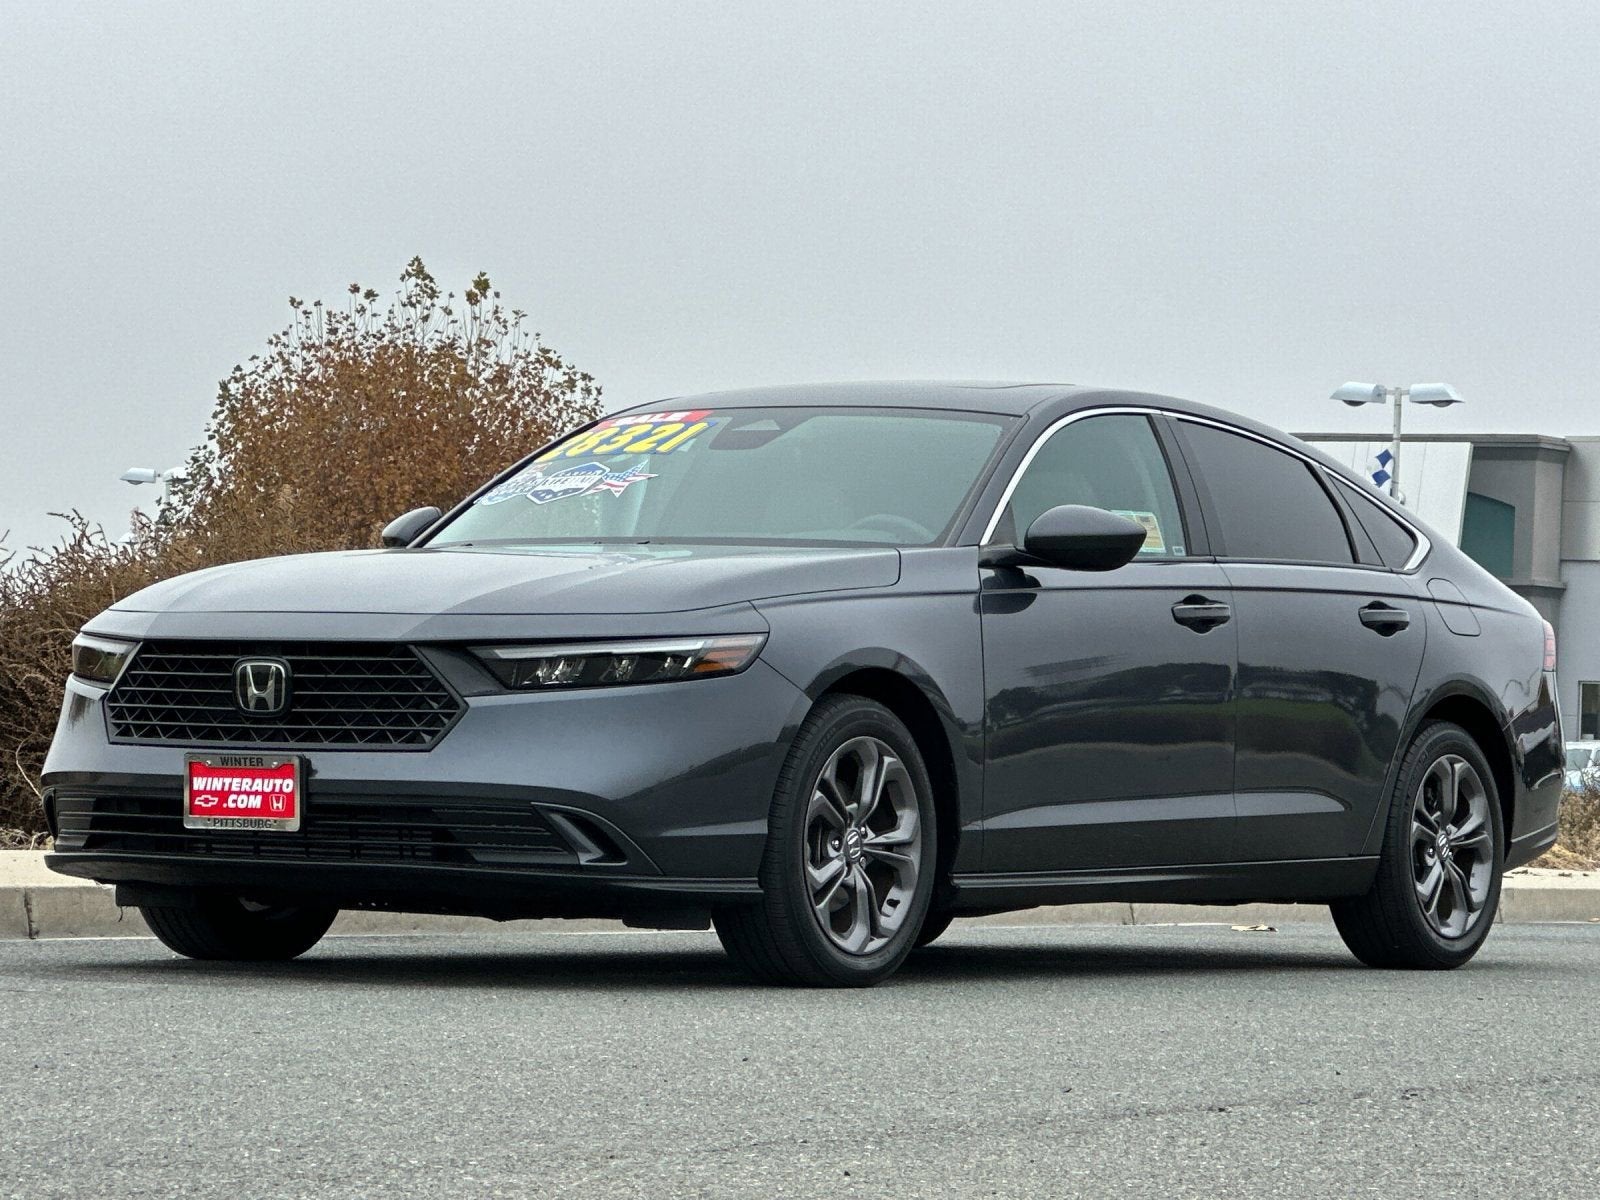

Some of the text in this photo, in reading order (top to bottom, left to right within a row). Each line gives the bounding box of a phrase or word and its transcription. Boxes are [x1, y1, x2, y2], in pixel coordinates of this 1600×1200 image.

[220, 757, 264, 767] WINTER
[192, 776, 294, 793] WINTERAUTO
[222, 794, 263, 809] .COM
[213, 818, 272, 829] PITTSBURG
